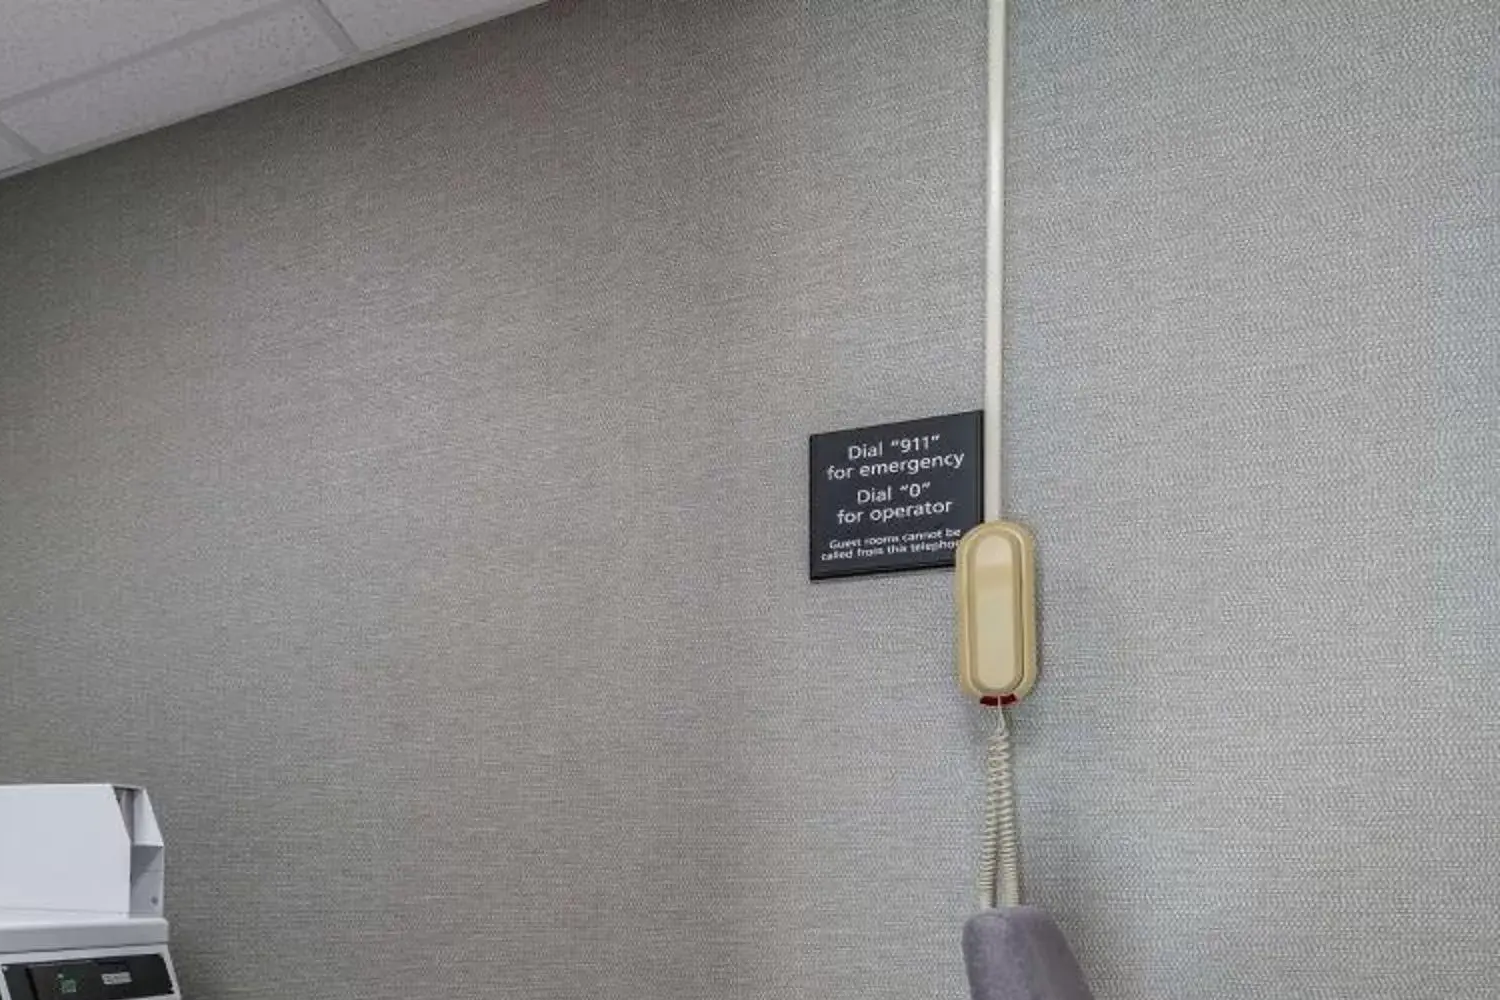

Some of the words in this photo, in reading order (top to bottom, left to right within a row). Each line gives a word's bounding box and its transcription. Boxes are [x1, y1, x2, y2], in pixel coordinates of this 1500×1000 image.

[847, 440, 883, 461] Dial
[890, 433, 941, 453] "911"
[826, 465, 856, 480] for
[859, 452, 965, 475] emergency
[856, 484, 892, 505] Dial
[836, 508, 865, 524] for
[869, 500, 953, 523] operator
[828, 538, 862, 550] Guest
[901, 529, 943, 543] cannot
[945, 527, 961, 537] be
[856, 546, 884, 557] from
